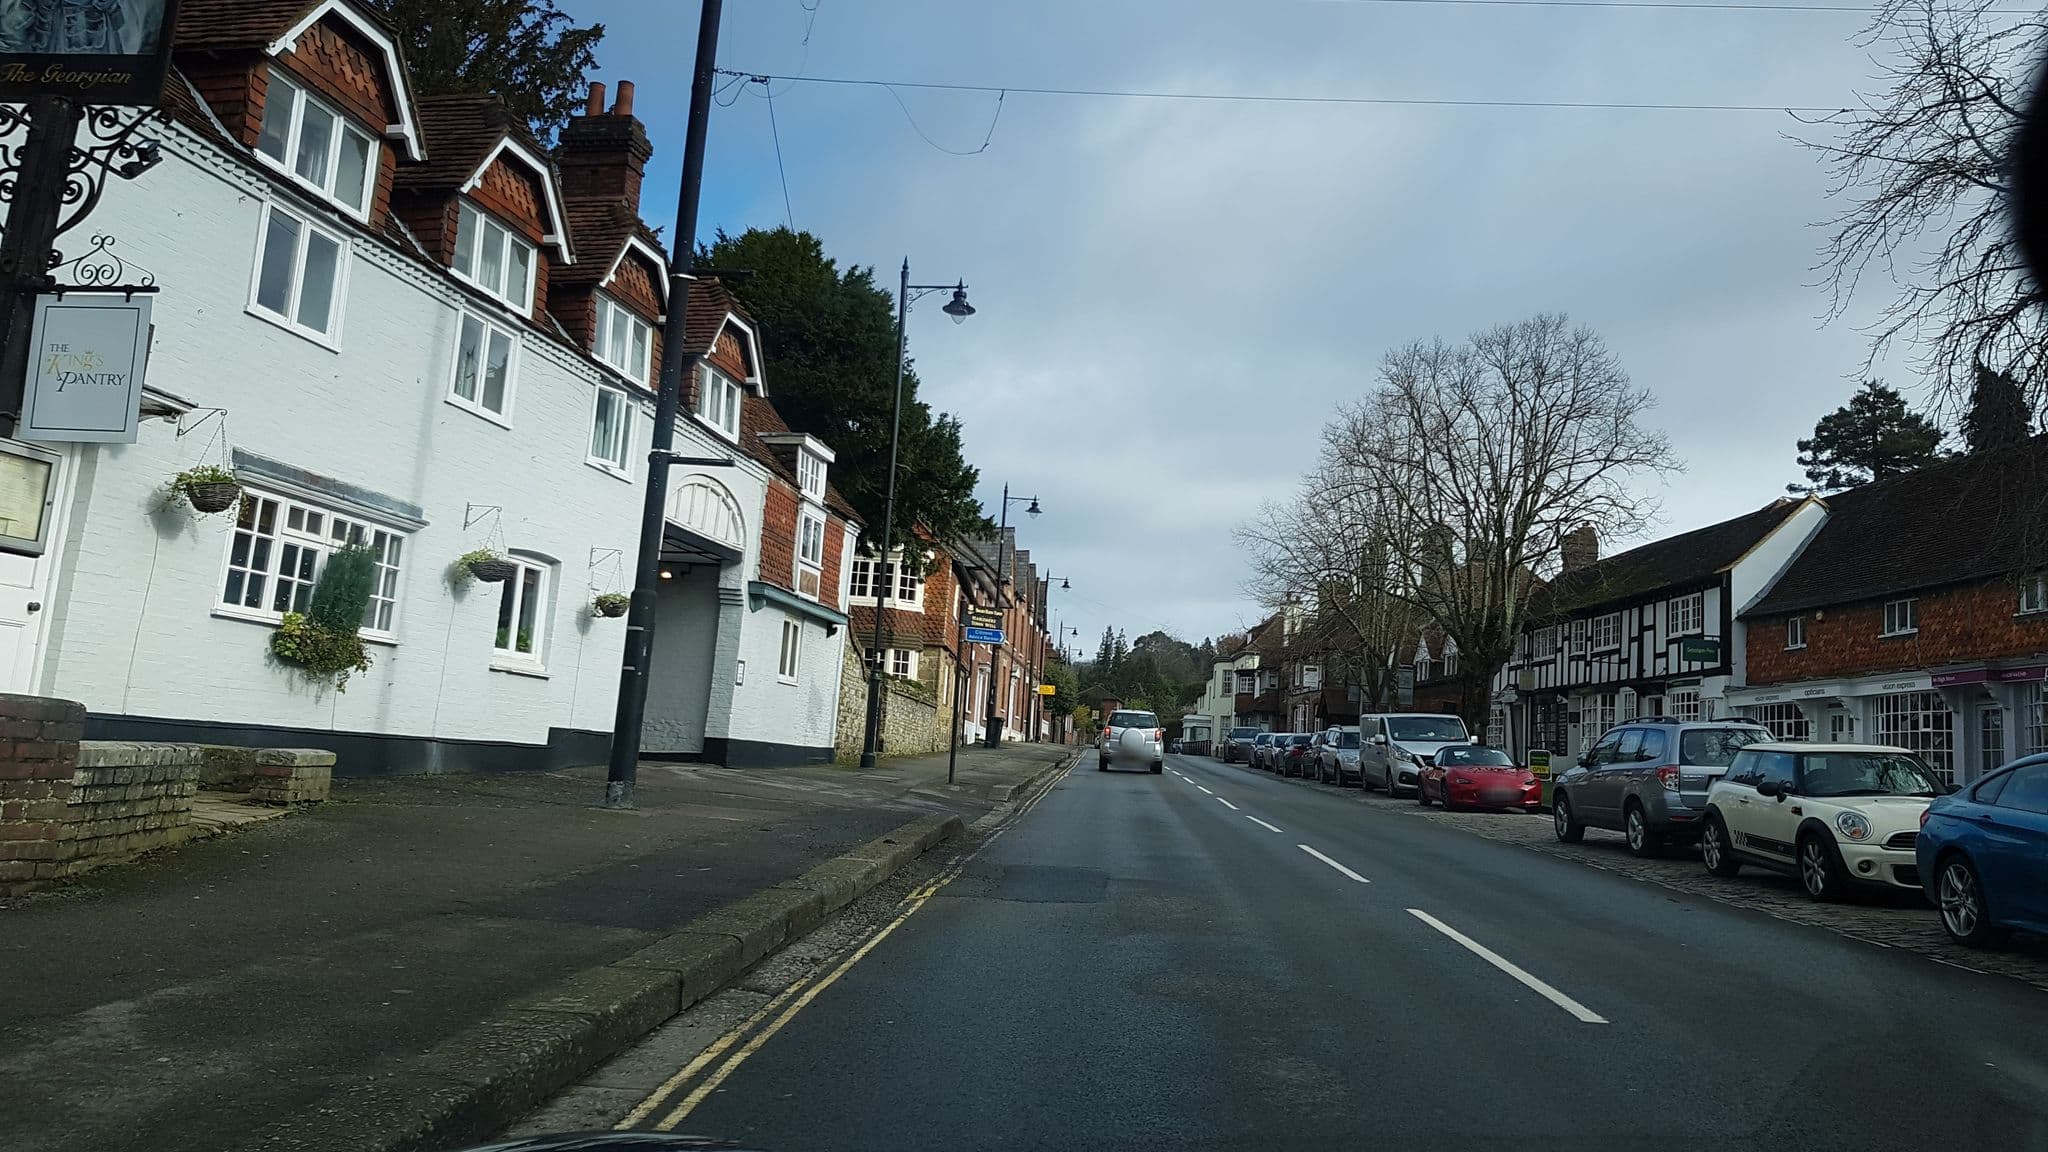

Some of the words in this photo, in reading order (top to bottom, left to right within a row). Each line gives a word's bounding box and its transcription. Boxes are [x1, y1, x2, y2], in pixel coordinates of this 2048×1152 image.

[0, 63, 36, 83] The
[40, 63, 133, 90] Georgian
[50, 343, 71, 353] THE
[56, 371, 126, 392] PANTRY
[1896, 681, 1915, 691] express
[1803, 688, 1824, 696] opticians
